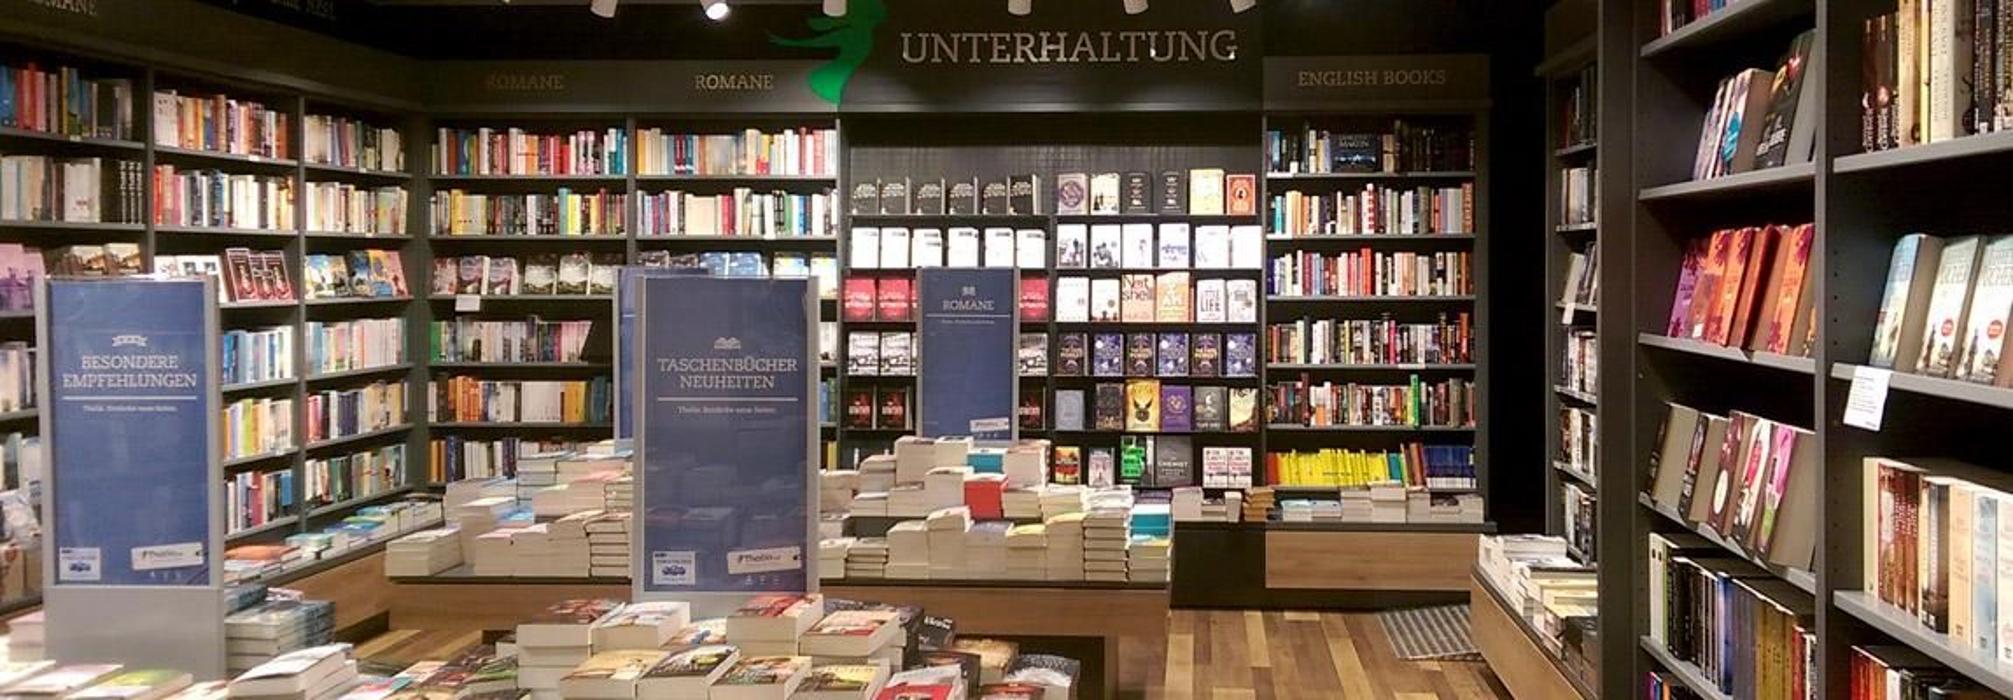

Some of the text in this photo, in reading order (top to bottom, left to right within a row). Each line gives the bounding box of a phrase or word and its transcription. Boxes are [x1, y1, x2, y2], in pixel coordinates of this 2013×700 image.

[900, 30, 1238, 63] UNTERHALTUNG
[695, 74, 773, 90] ROMANE
[1298, 69, 1447, 87] ENGLISH BOOKS
[943, 300, 995, 311] ROMANE
[81, 354, 179, 369] BESONDERE
[657, 356, 798, 372] TASCHENBÜCHER
[62, 373, 197, 388] EMPFEHLUNGEN
[679, 375, 775, 389] NEUHEITEN
